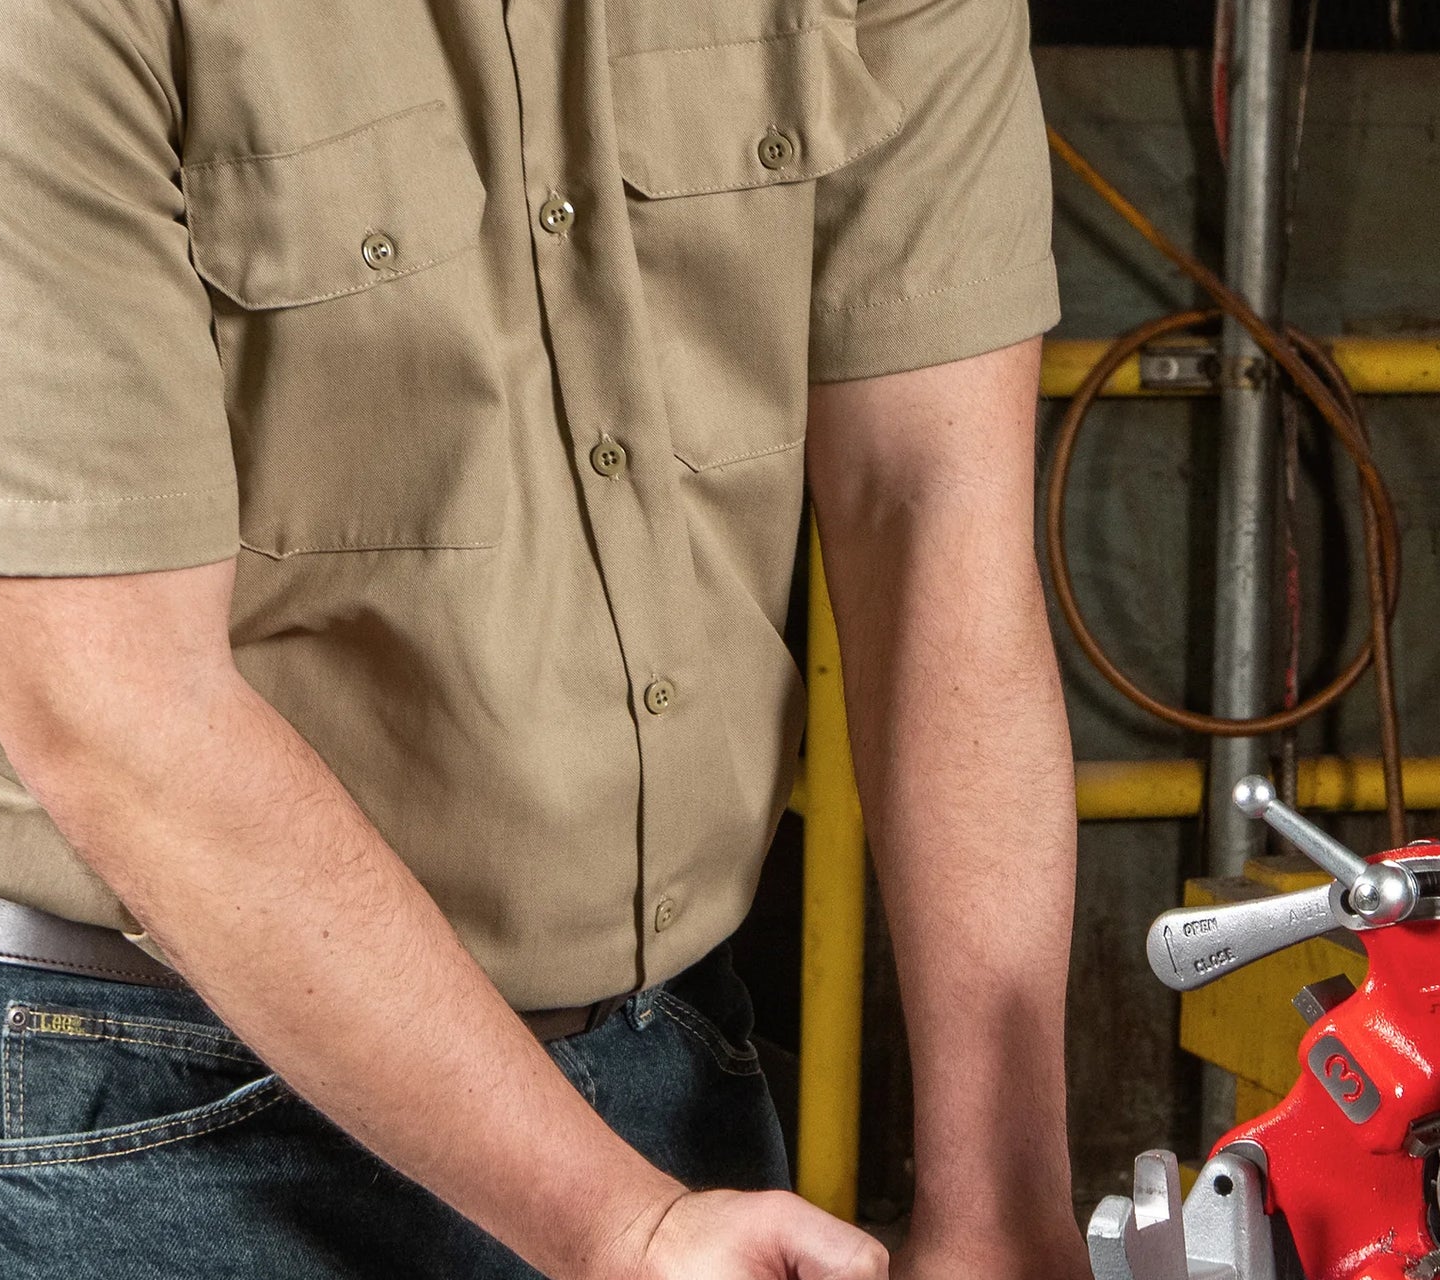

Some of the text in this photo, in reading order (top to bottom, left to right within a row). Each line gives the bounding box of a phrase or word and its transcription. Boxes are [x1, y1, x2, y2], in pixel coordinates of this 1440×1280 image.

[1182, 917, 1218, 938] OPEN
[39, 1013, 72, 1032] Lee
[1324, 1053, 1364, 1103] 3
